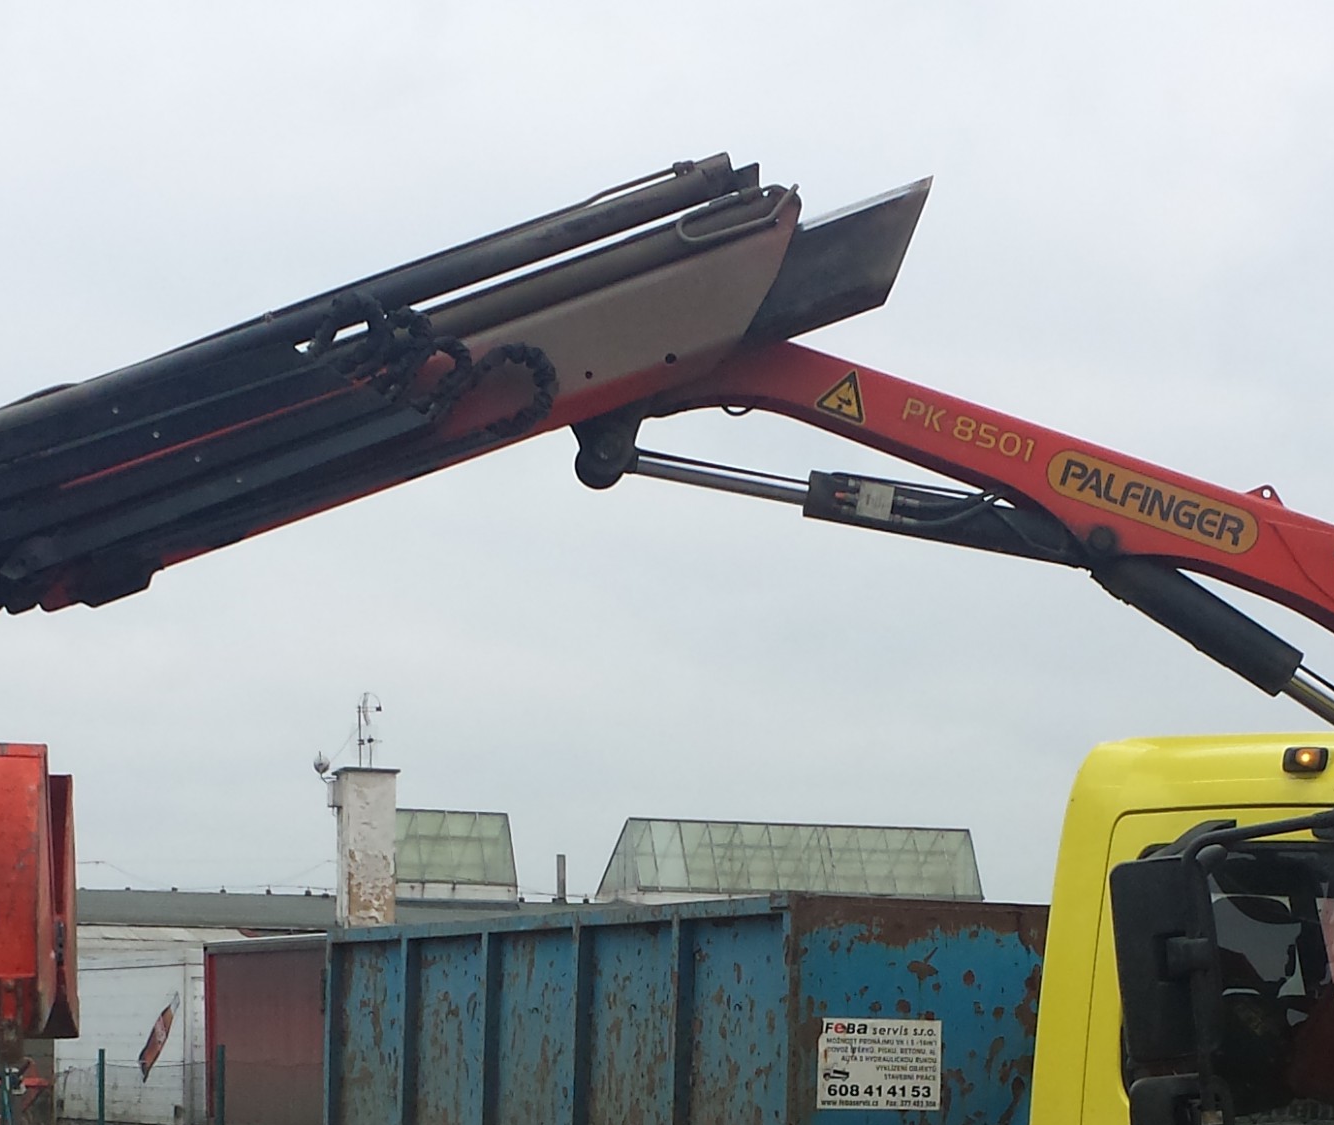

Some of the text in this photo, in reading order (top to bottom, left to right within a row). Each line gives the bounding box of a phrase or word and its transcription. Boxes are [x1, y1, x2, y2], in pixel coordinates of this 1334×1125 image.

[902, 397, 1035, 462] PK 8501
[1060, 458, 1245, 547] PALFINGER
[824, 1022, 868, 1035] FeBa
[872, 1025, 909, 1036] servis
[827, 1084, 931, 1098] 608 41 41 53
